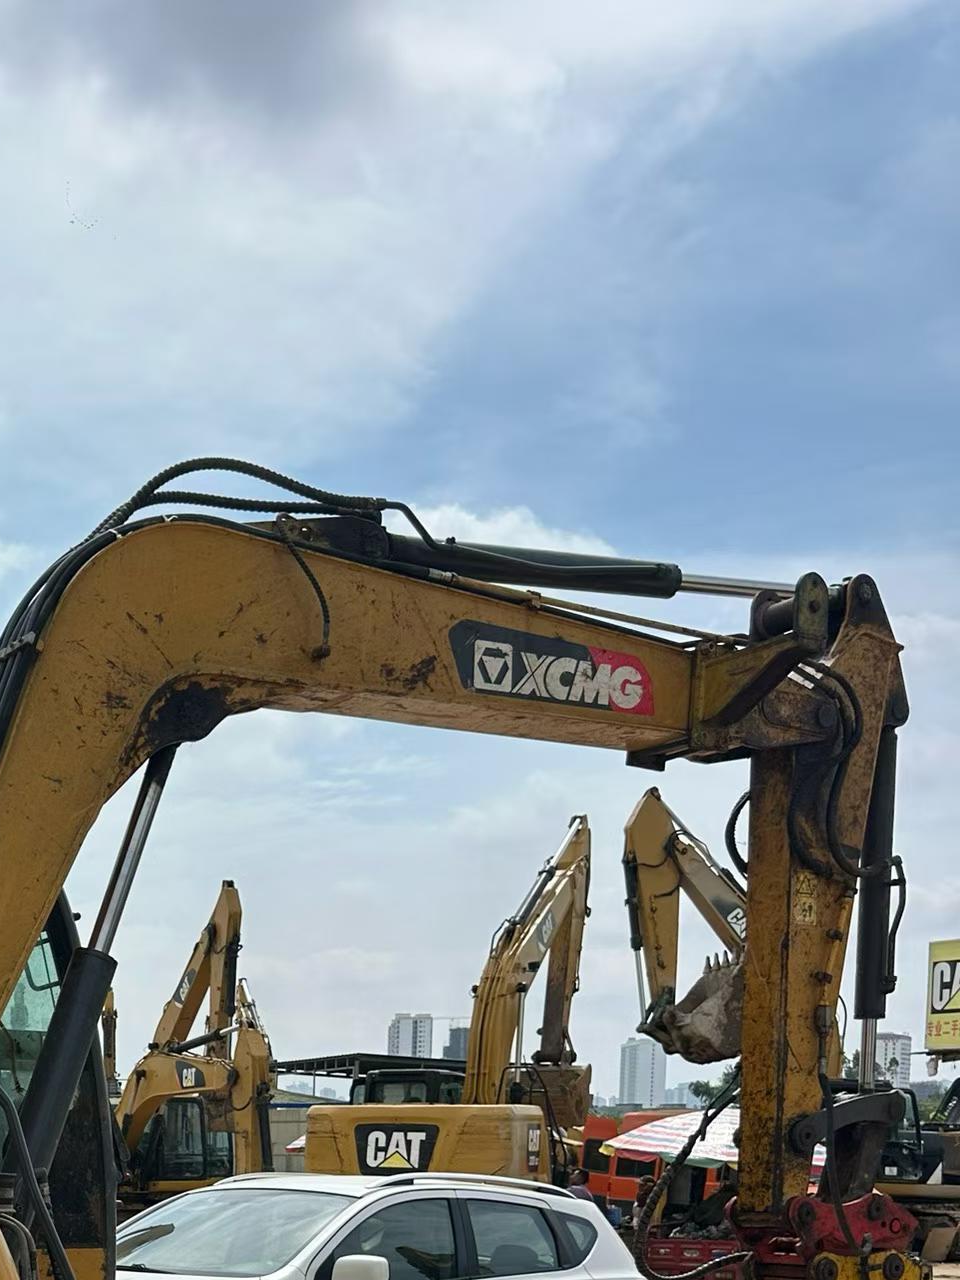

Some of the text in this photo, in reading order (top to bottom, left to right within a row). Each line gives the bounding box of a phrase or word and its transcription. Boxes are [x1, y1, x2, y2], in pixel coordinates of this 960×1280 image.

[512, 651, 643, 709] XCMG
[927, 1020, 960, 1037] 专业二手
[183, 1068, 196, 1087] CAT
[366, 1131, 426, 1168] CAT
